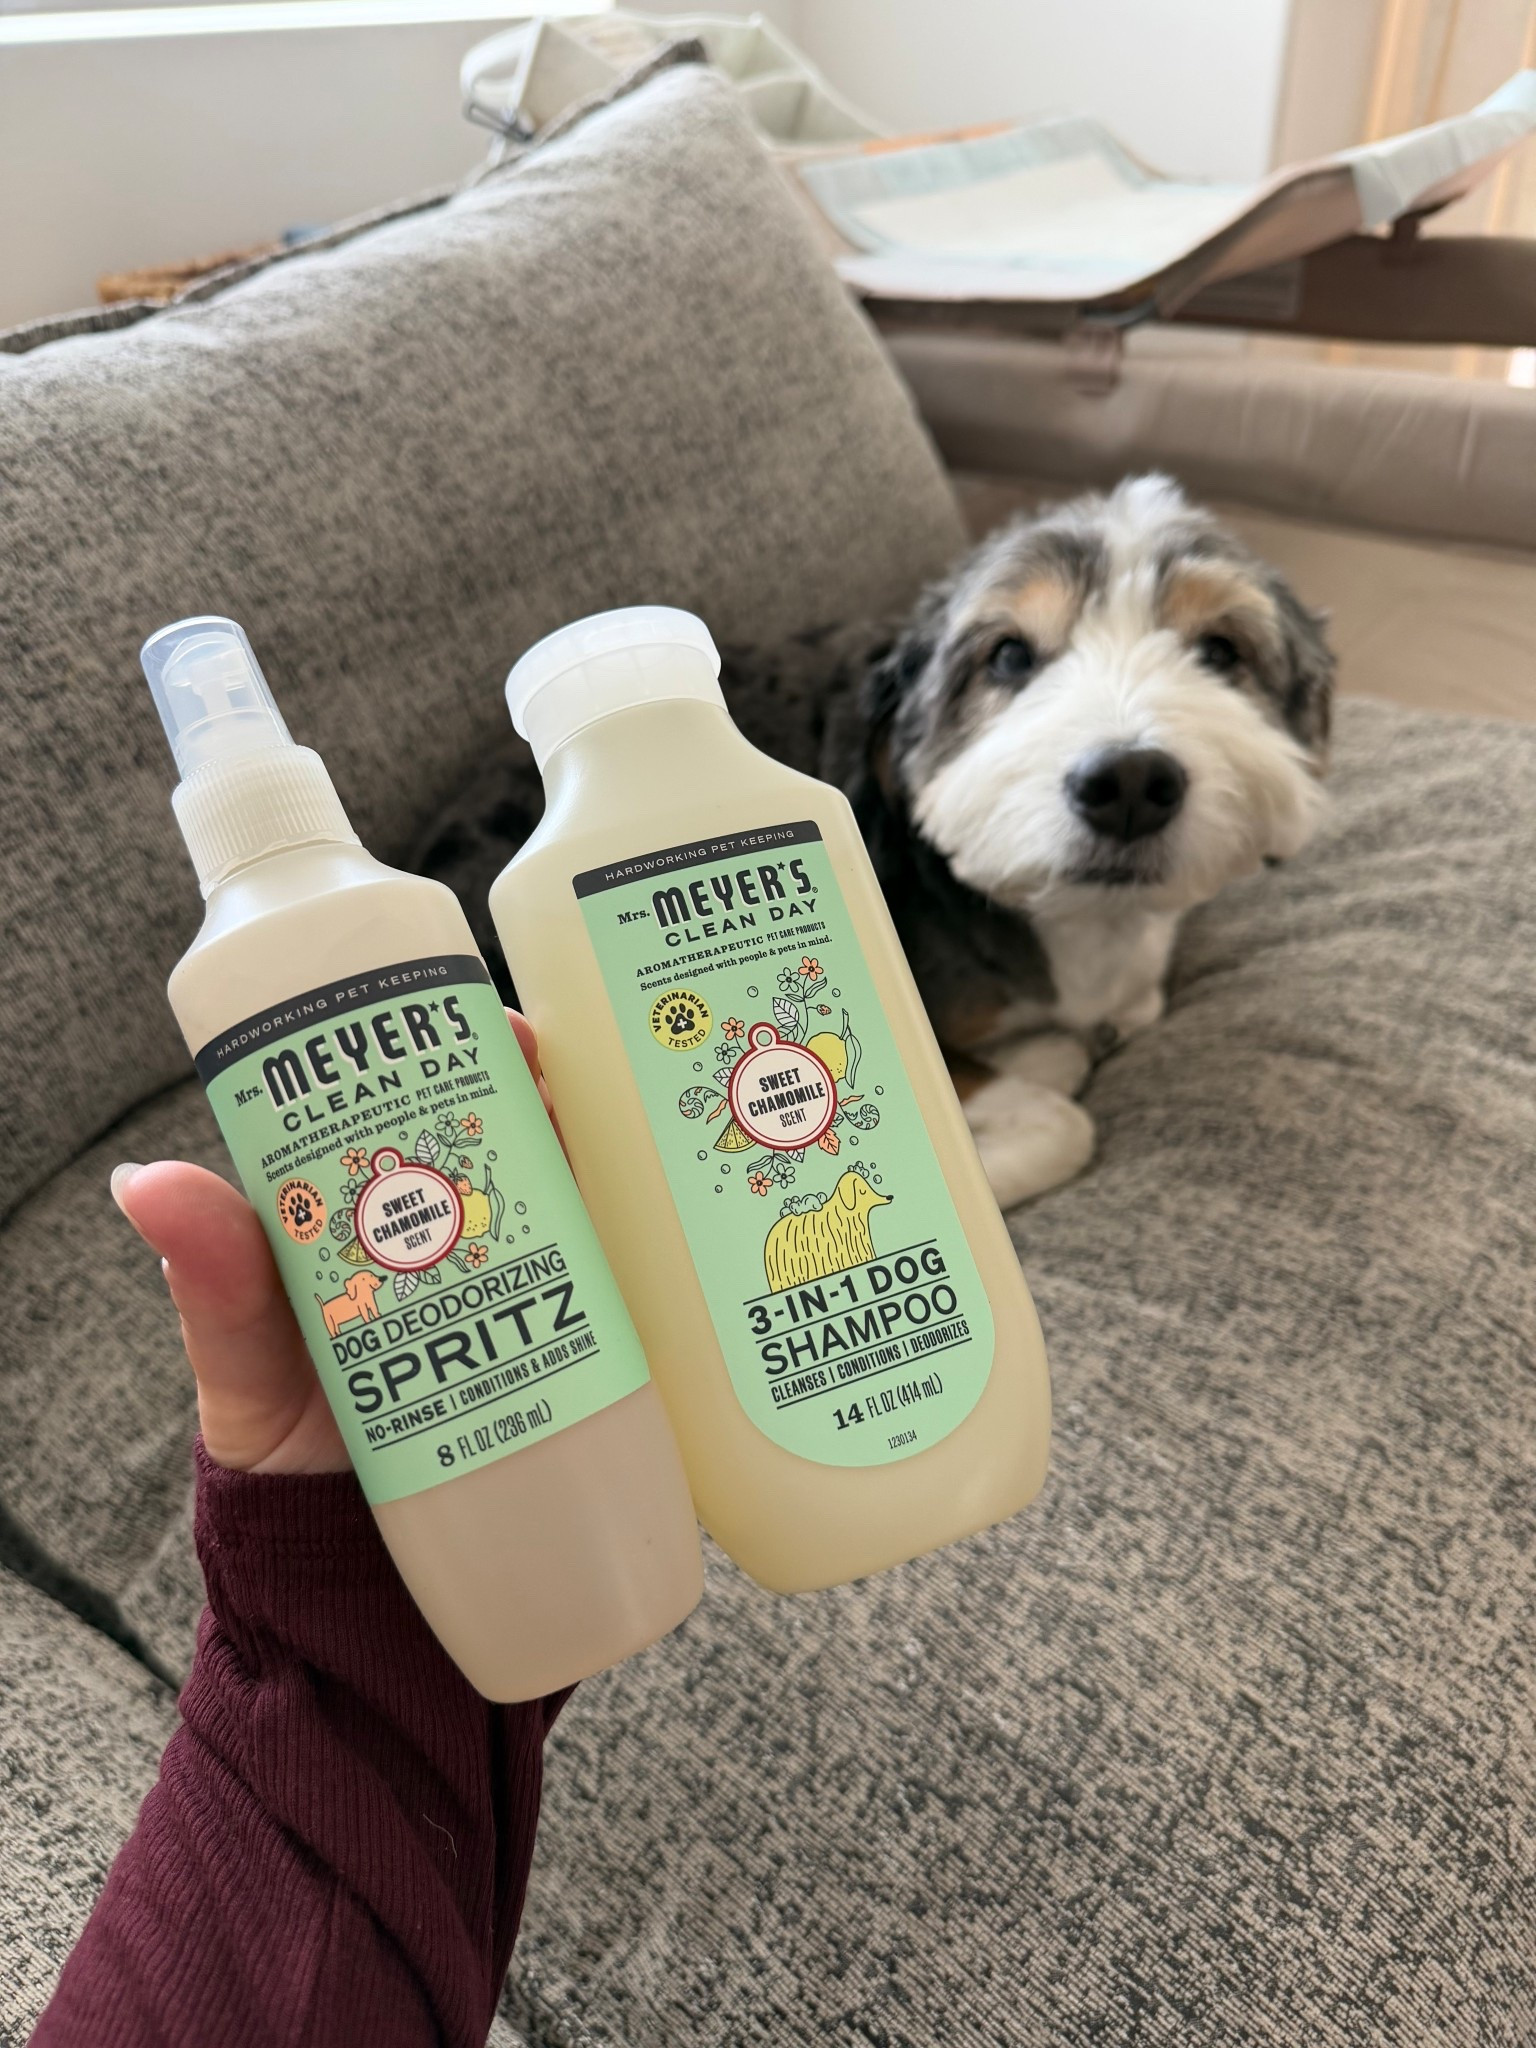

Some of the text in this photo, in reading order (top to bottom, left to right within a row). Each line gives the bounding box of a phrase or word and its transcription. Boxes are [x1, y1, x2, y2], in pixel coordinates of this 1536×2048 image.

[605, 830, 795, 881] HARDWORKING PET KEEPING
[617, 909, 651, 924] Mrs.
[665, 898, 817, 947] CLEAN DAY
[636, 921, 826, 978] AROMATHERAPEUTIC PET CARE PRODUCTS
[640, 935, 833, 992] Scents designed with people & pets in mind.
[216, 966, 448, 1060] HARDWORKING PET KEEPING
[652, 991, 710, 1032] VETERINARIAN
[667, 1028, 706, 1048] TESTED
[234, 1085, 263, 1106] Mrs.
[282, 1047, 479, 1133] CLEAN DAY
[748, 1082, 826, 1117] CHAMOMILE
[759, 1068, 801, 1093] SWEET
[260, 1070, 490, 1169] AROMATHERAPEUTIC PET CARE PRODUCTS
[266, 1084, 498, 1181] Scents designed with people & pets in mind.
[779, 1108, 807, 1128] SCENT
[280, 1180, 324, 1223] VETERINARIAN
[372, 1200, 452, 1243] CHAMOMILE
[382, 1188, 426, 1218] SWEET
[294, 1218, 323, 1240] TESTED
[404, 1228, 433, 1250] SCENT
[332, 1250, 568, 1366] DOG DEODORIZING
[748, 1248, 947, 1334] 3-IN-1 DOG
[348, 1280, 586, 1414] SPRITZ
[761, 1284, 957, 1375] SHAMPOO
[365, 1330, 597, 1444] NO-RINSE CONDITIONS & ADDS SHINE
[771, 1320, 970, 1403] CLEANSES CONDITIONS DEODORIZES
[833, 1372, 943, 1430] 14 FL OZ (414 mL)
[436, 1399, 552, 1467] 8 FL OZ (236 mL)
[888, 1429, 918, 1449] 1230134
